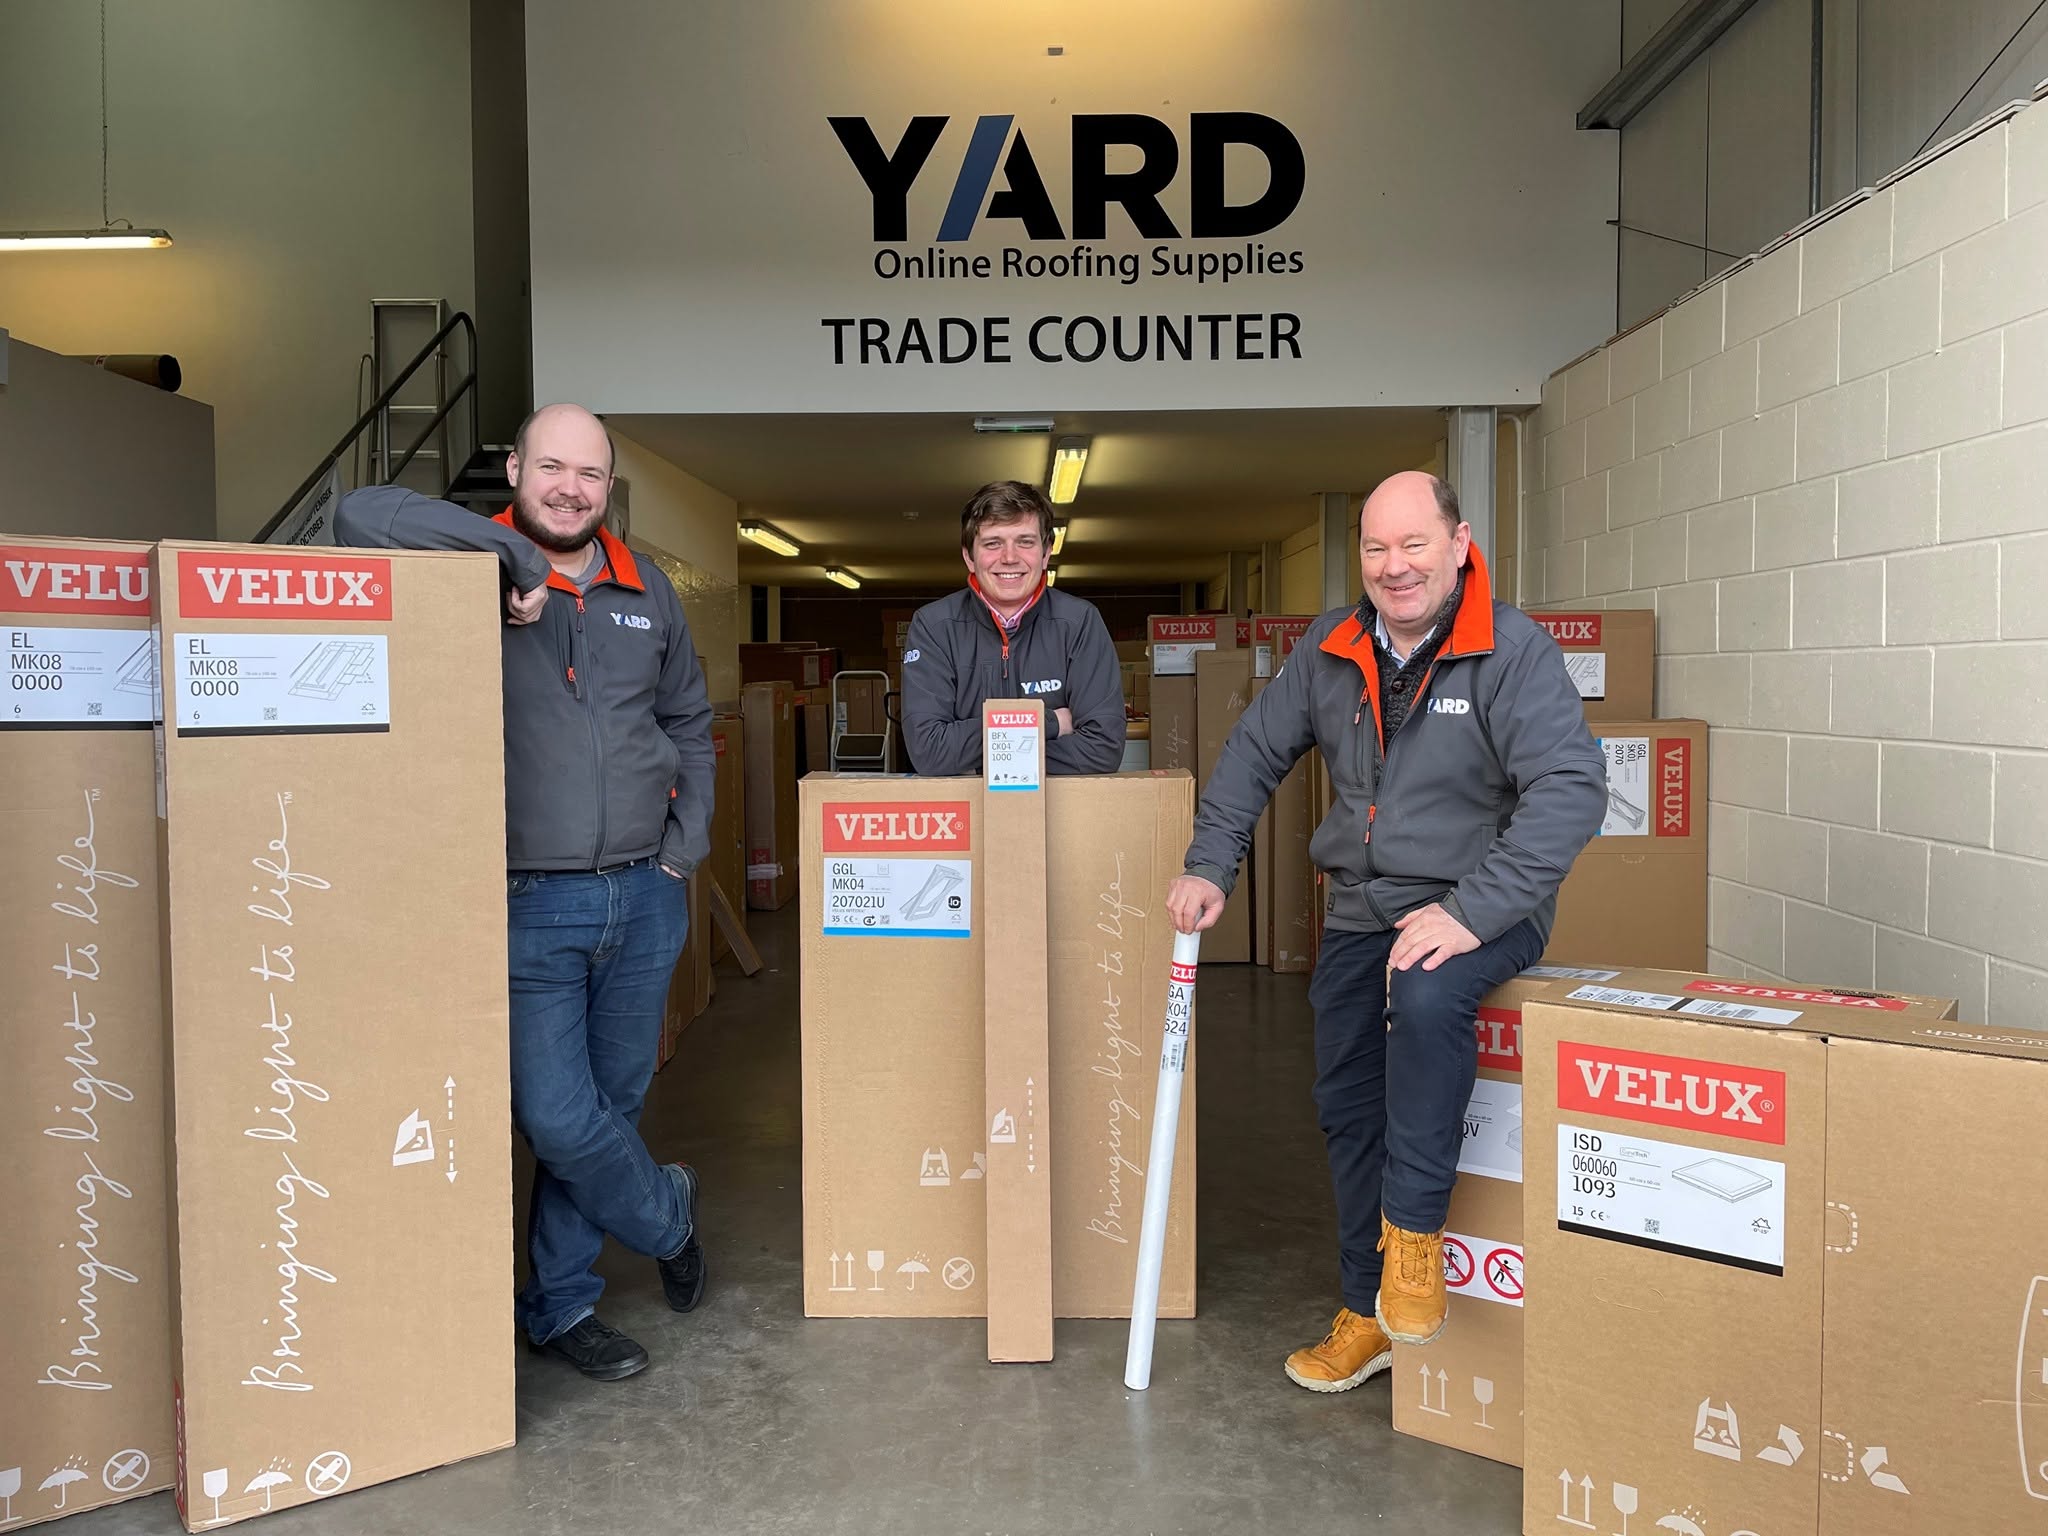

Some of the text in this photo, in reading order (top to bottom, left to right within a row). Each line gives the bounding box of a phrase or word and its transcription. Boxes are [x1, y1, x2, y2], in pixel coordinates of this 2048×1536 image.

[826, 111, 1306, 242] YARD
[874, 243, 1304, 284] Online Roofing Supplies
[821, 312, 1304, 364] TRADE COUNTER
[610, 612, 651, 630] YARD
[1540, 621, 1593, 639] LUX
[11, 632, 34, 649] EL
[189, 638, 211, 655] EL
[11, 654, 62, 670] MK08
[189, 660, 238, 676] MK08
[11, 675, 63, 691] 0000
[190, 681, 239, 696] 0000
[1020, 679, 1062, 695] YARD
[14, 704, 21, 715] 6
[193, 711, 200, 720] 6
[1638, 744, 1647, 760] GGL
[832, 863, 857, 876] GGL
[832, 878, 865, 890] MK04
[832, 896, 885, 908] 207021U
[53, 943, 100, 980] to
[250, 944, 296, 982] to
[1097, 950, 1124, 977] to
[1092, 983, 1142, 1081] light
[44, 991, 135, 1143] light
[244, 992, 330, 1143] light
[1573, 1132, 1602, 1152] ISD
[1086, 1083, 1144, 1244] Bringing
[1572, 1154, 1617, 1177] 060060
[1572, 1175, 1616, 1198] 1093
[1572, 1206, 1584, 1217] 15
[38, 1152, 139, 1391] Bringing
[241, 1152, 338, 1391] Bringing
